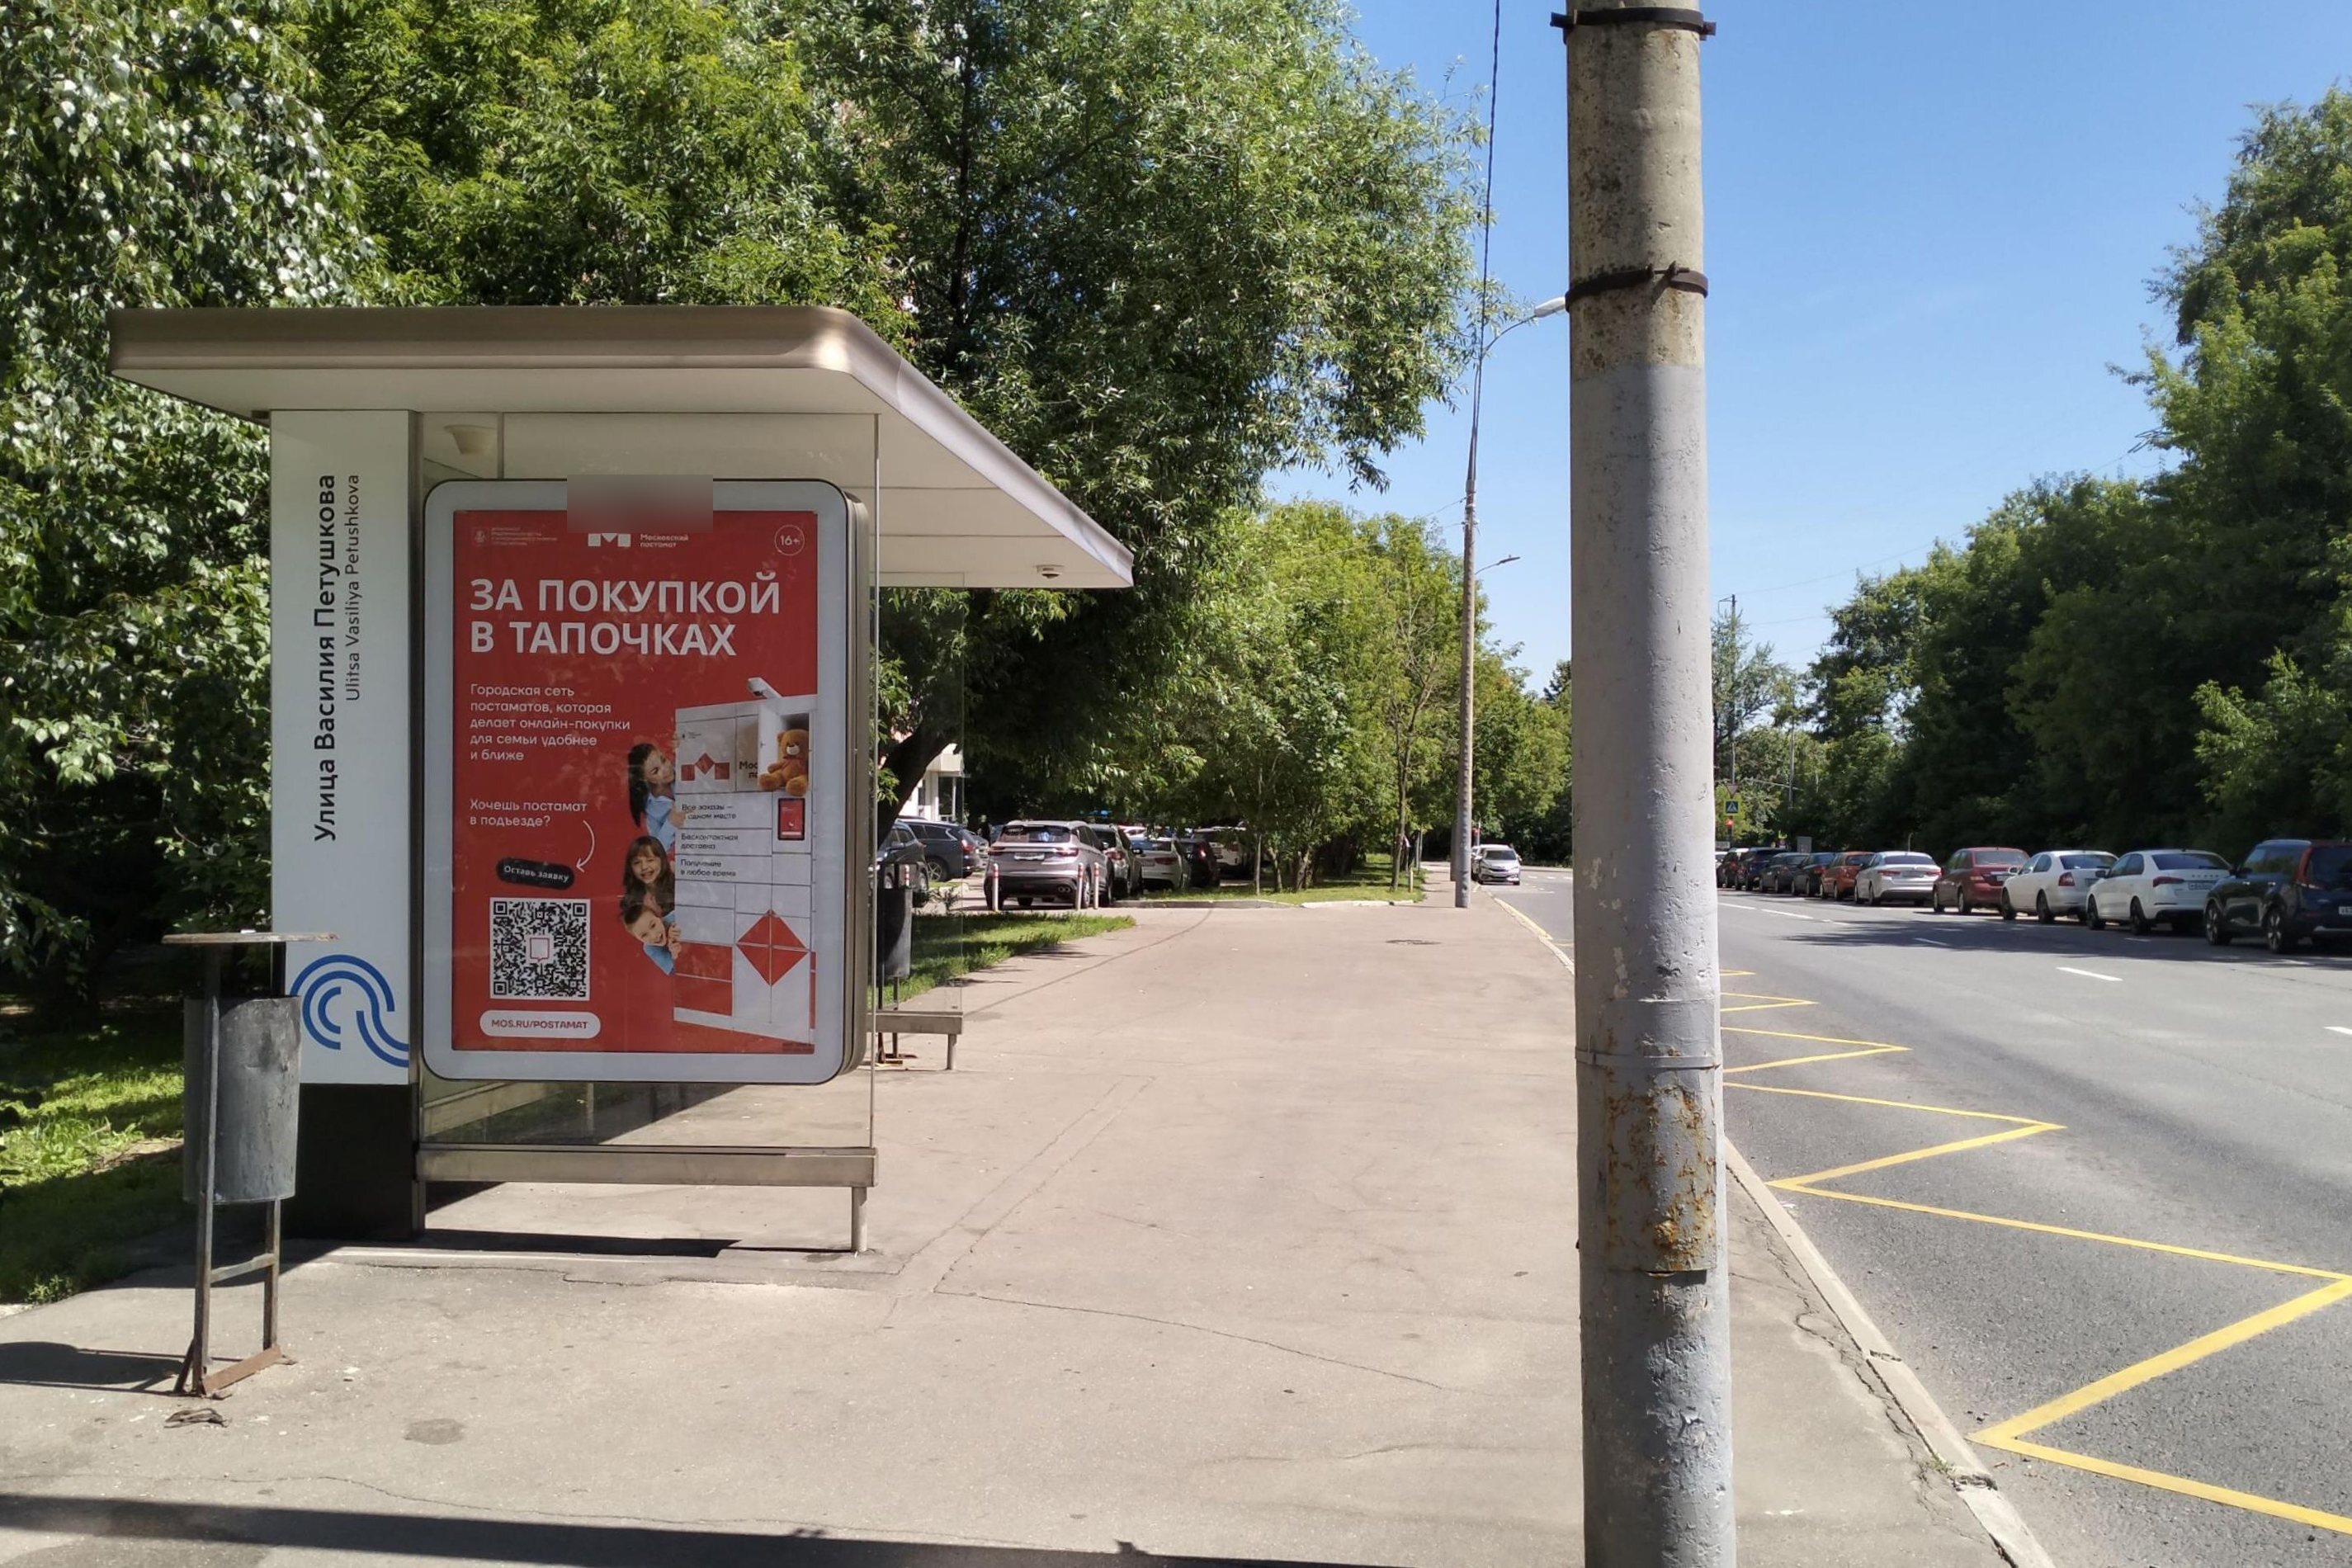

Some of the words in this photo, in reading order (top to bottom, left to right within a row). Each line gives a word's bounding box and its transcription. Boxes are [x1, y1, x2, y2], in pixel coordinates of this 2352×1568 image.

[345, 475, 360, 574] Petushkova
[780, 535, 801, 545] 16+
[314, 475, 340, 626] Петушкова
[470, 579, 523, 612] ЗА
[539, 571, 780, 614] ПОКУПКОЙ
[345, 579, 362, 648] Vasiliya
[470, 621, 494, 654] В
[509, 621, 738, 656] ТАПОЧКАХ
[345, 653, 360, 701] Ulitsa
[314, 636, 335, 749] Василия
[470, 683, 541, 698] Городская
[544, 686, 575, 697] сеть
[470, 701, 553, 714] постаматов,
[556, 703, 612, 716] которая
[470, 717, 517, 729] делает
[519, 717, 631, 732] онлайн-покупки
[470, 735, 493, 745] для
[496, 735, 537, 744] семьи
[541, 734, 597, 748] удобнее
[470, 752, 478, 760] и
[481, 750, 525, 761] ближе
[314, 759, 338, 841] Улица
[470, 799, 520, 810] Хочешь
[523, 801, 588, 812] постамат
[470, 816, 477, 824] в
[480, 815, 551, 828] подъезде?
[503, 865, 536, 877] Оставь
[537, 871, 570, 883] заявку
[490, 1019, 588, 1030] MOS.RU/POSTAMAT
